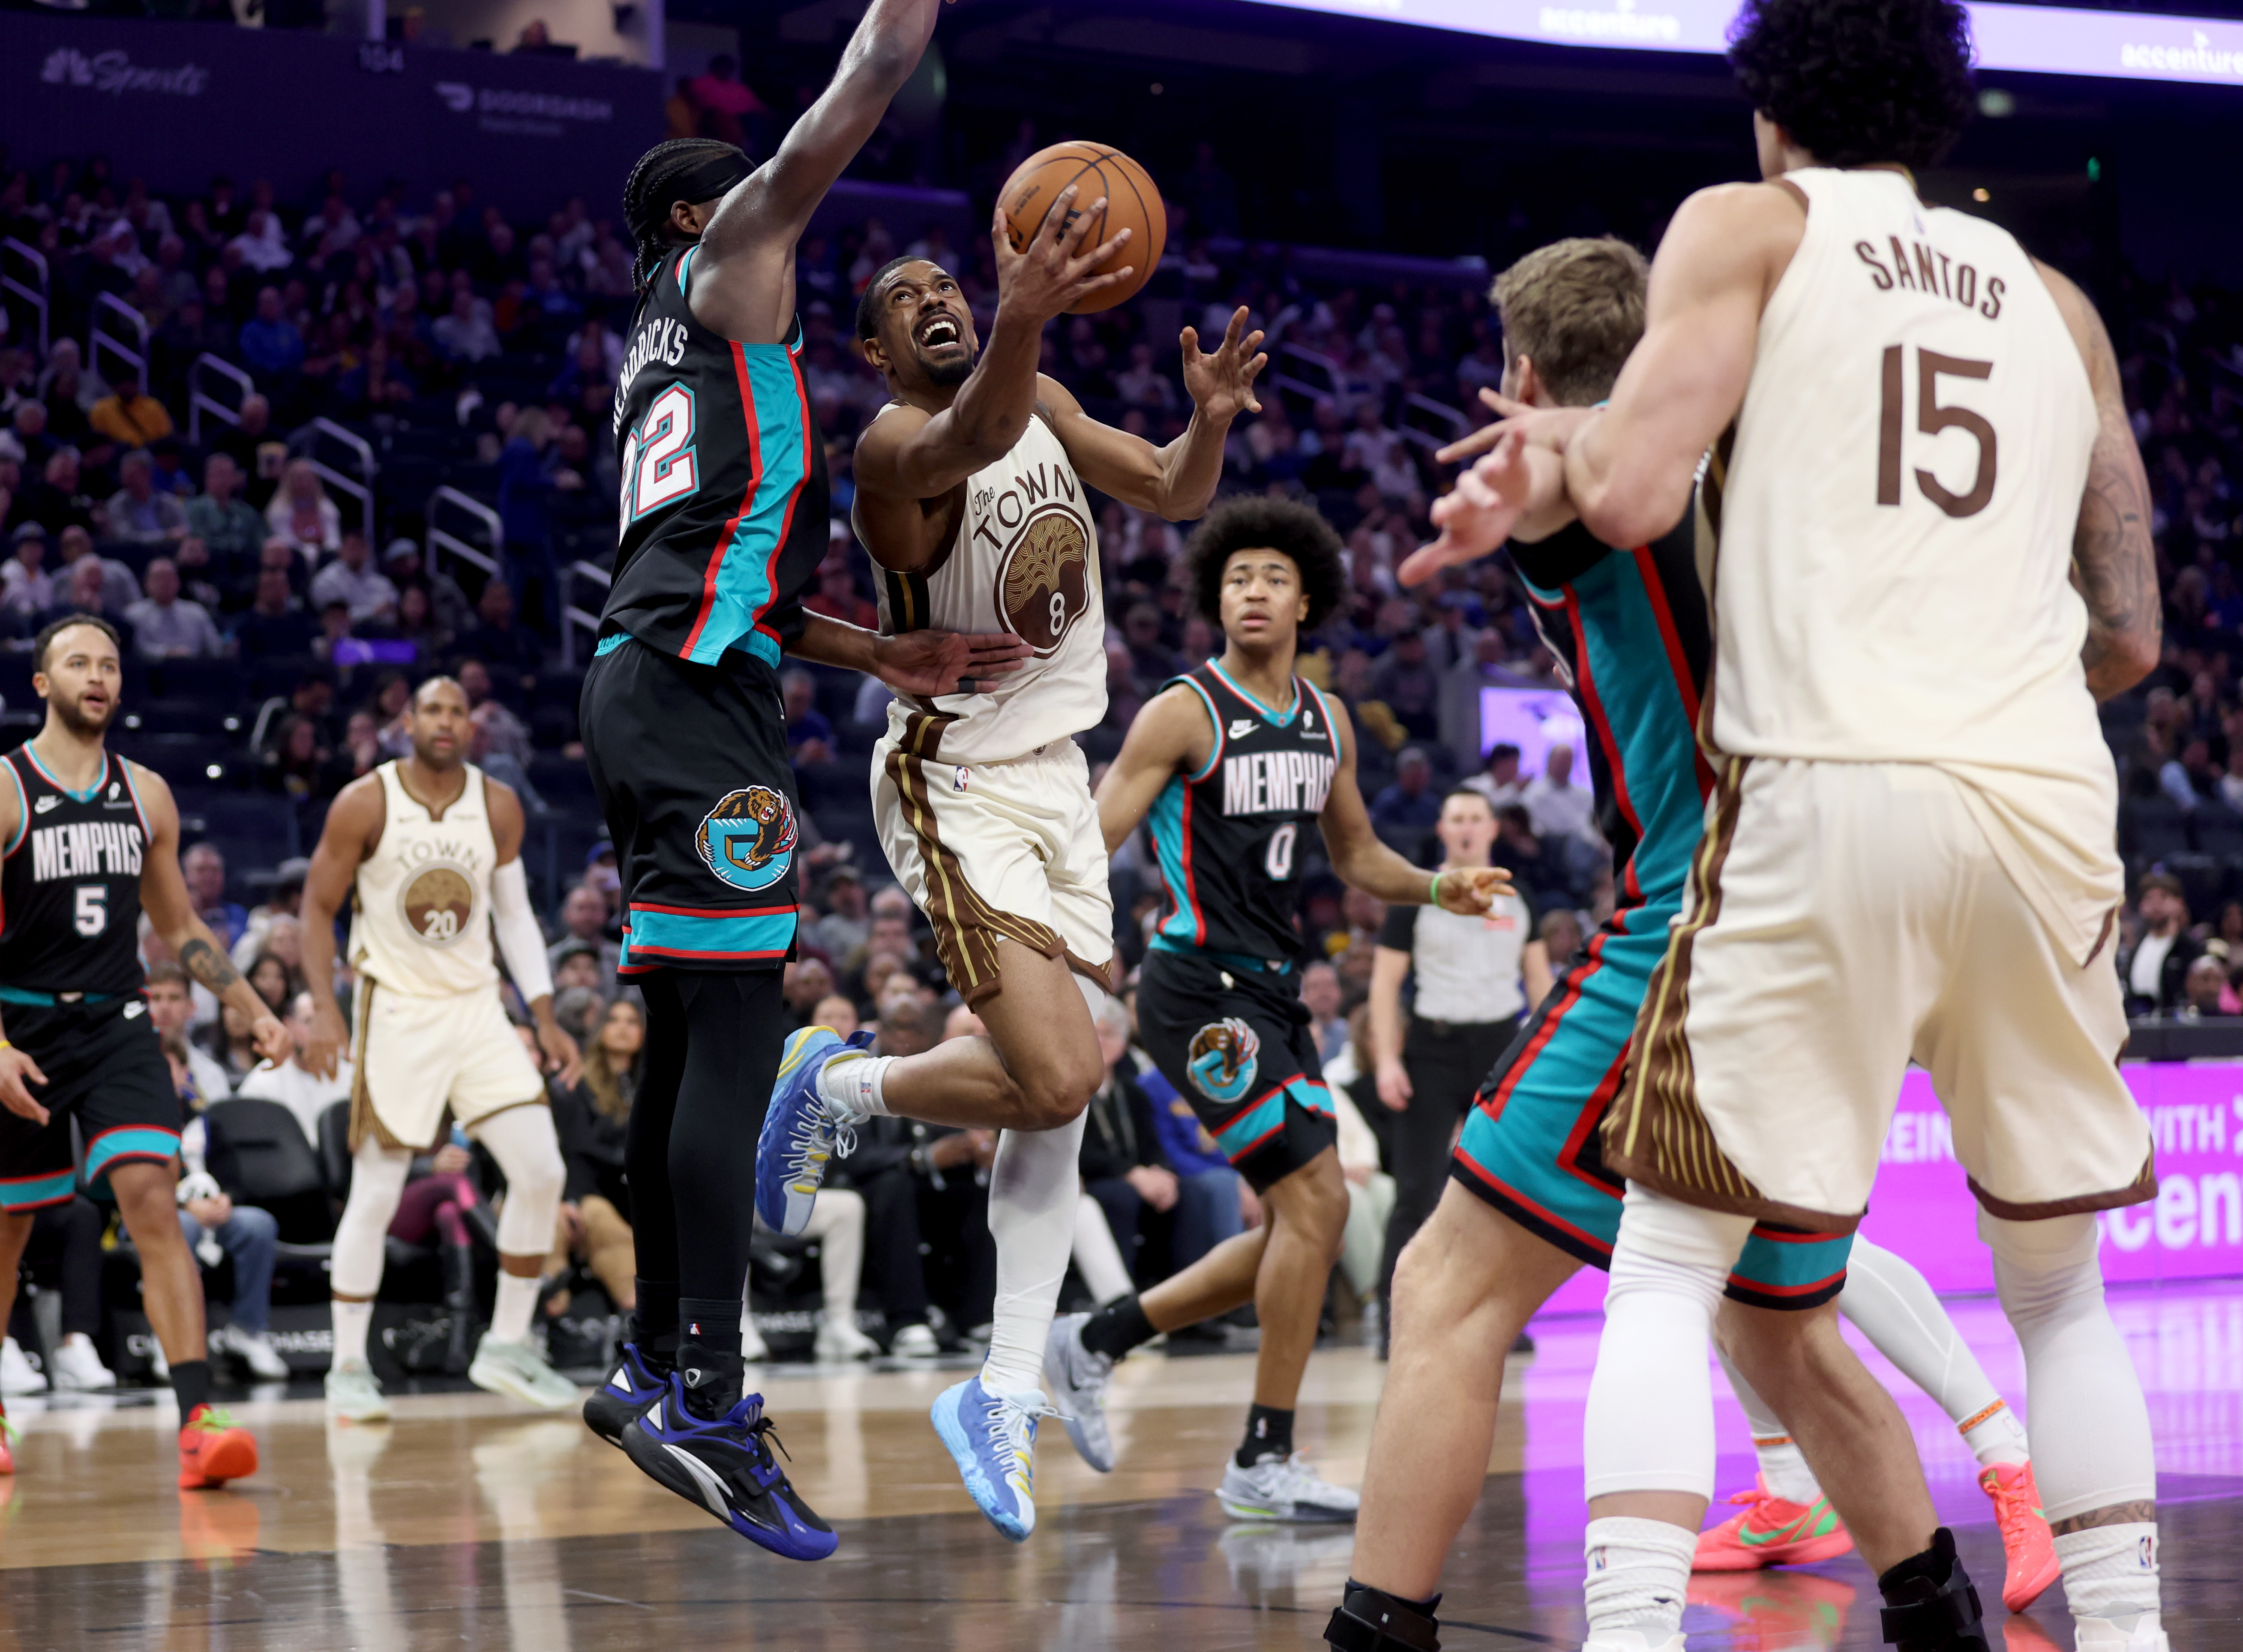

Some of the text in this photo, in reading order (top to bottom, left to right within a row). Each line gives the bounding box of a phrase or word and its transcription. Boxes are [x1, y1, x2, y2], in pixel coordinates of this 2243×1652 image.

[1854, 235, 2006, 320] SANTOS
[1877, 344, 1997, 519] 15
[619, 381, 700, 547] 22
[972, 462, 1075, 550] TOWN
[974, 486, 996, 516] The
[1050, 592, 1065, 636] 8
[1223, 751, 1335, 816] MEMPHIS
[32, 822, 143, 883] MEMPHIS
[397, 838, 483, 871] TOWN
[1265, 821, 1298, 880] 0
[73, 883, 108, 938] 5
[423, 909, 458, 939] 20
